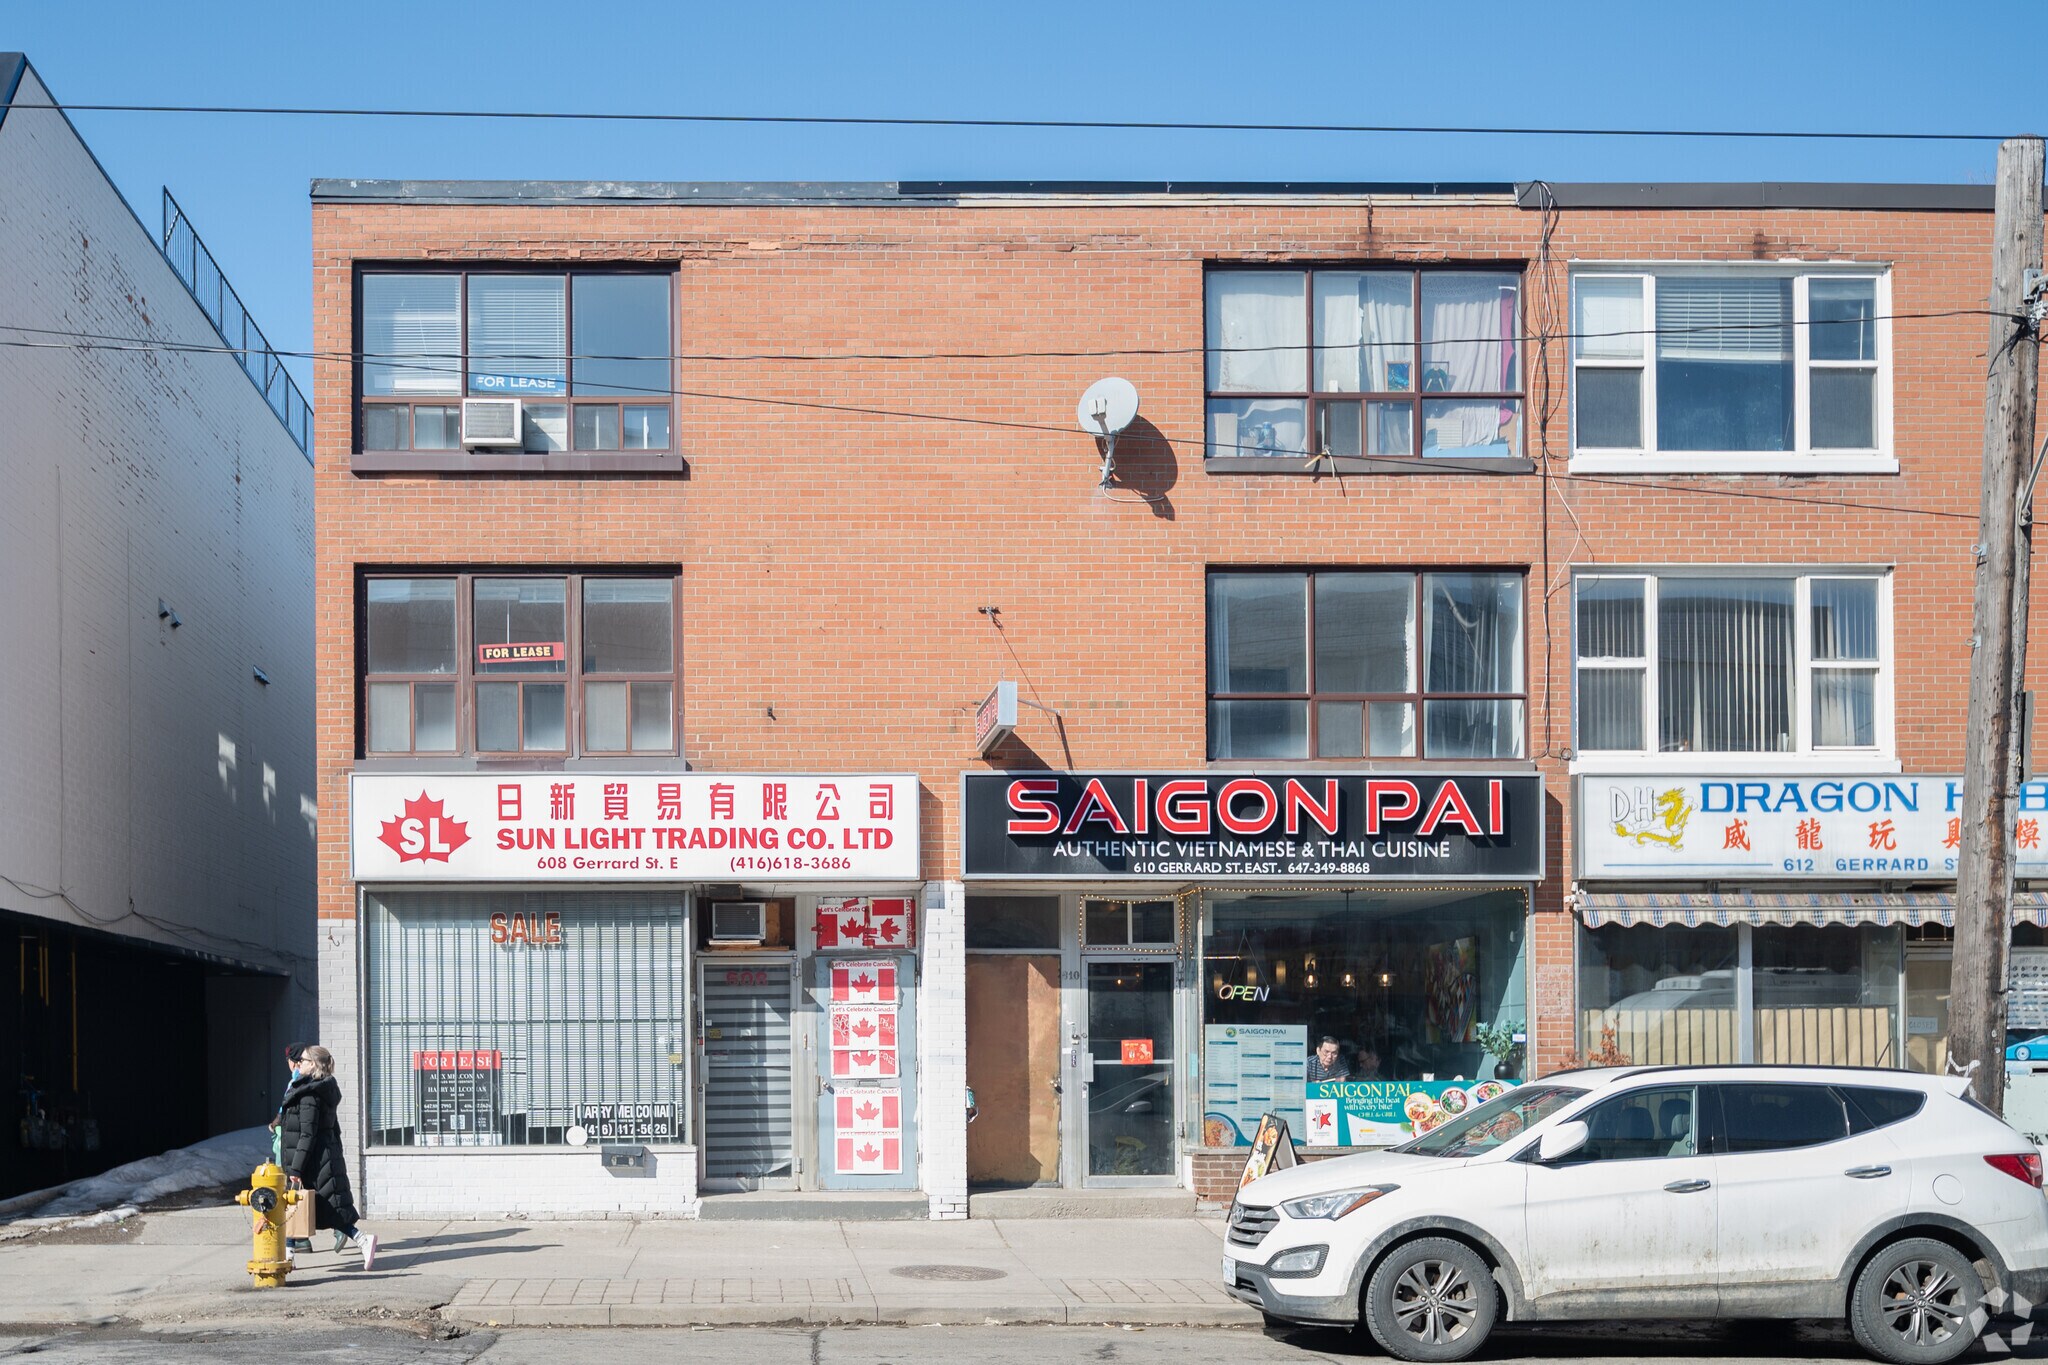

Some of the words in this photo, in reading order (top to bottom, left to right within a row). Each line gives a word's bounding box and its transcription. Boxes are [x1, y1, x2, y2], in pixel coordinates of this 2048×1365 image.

[476, 377, 505, 388] FOR
[510, 377, 556, 389] LEASE
[485, 648, 509, 658] FOR
[513, 646, 551, 657] LEASE
[498, 783, 893, 820] 日新貿易有限公司
[1700, 782, 1919, 813] DRAGON
[1007, 778, 1339, 835] SAIGON
[1366, 779, 1504, 836] PAI
[400, 817, 450, 854] SL
[497, 828, 555, 850] SUN
[564, 828, 646, 850] LIGHT
[652, 828, 778, 850] TRADING
[787, 828, 834, 850] CO.
[843, 828, 894, 850] LTD
[1053, 841, 1170, 857] AUTHENTIC
[1176, 841, 1296, 858] VIETNAMESE
[1301, 842, 1315, 858] &
[1317, 842, 1365, 858] THAI
[1371, 842, 1450, 858] CUISINE
[537, 857, 567, 869] 608
[573, 857, 640, 869] Gerrard
[645, 857, 664, 869] St.
[670, 857, 678, 869] E
[730, 857, 851, 872] (416)618-3686
[1133, 862, 1156, 874] 610
[1158, 862, 1222, 874] GERRARD
[1288, 862, 1370, 874] 647-349-8868
[1783, 858, 1814, 872] 612
[1836, 858, 1928, 871] GERRARD
[490, 912, 561, 944] SALE
[1219, 984, 1270, 1001] OPEN
[1320, 1083, 1382, 1098] SAIGON
[1386, 1083, 1410, 1097] PAI
[1345, 1097, 1373, 1105] Bringing
